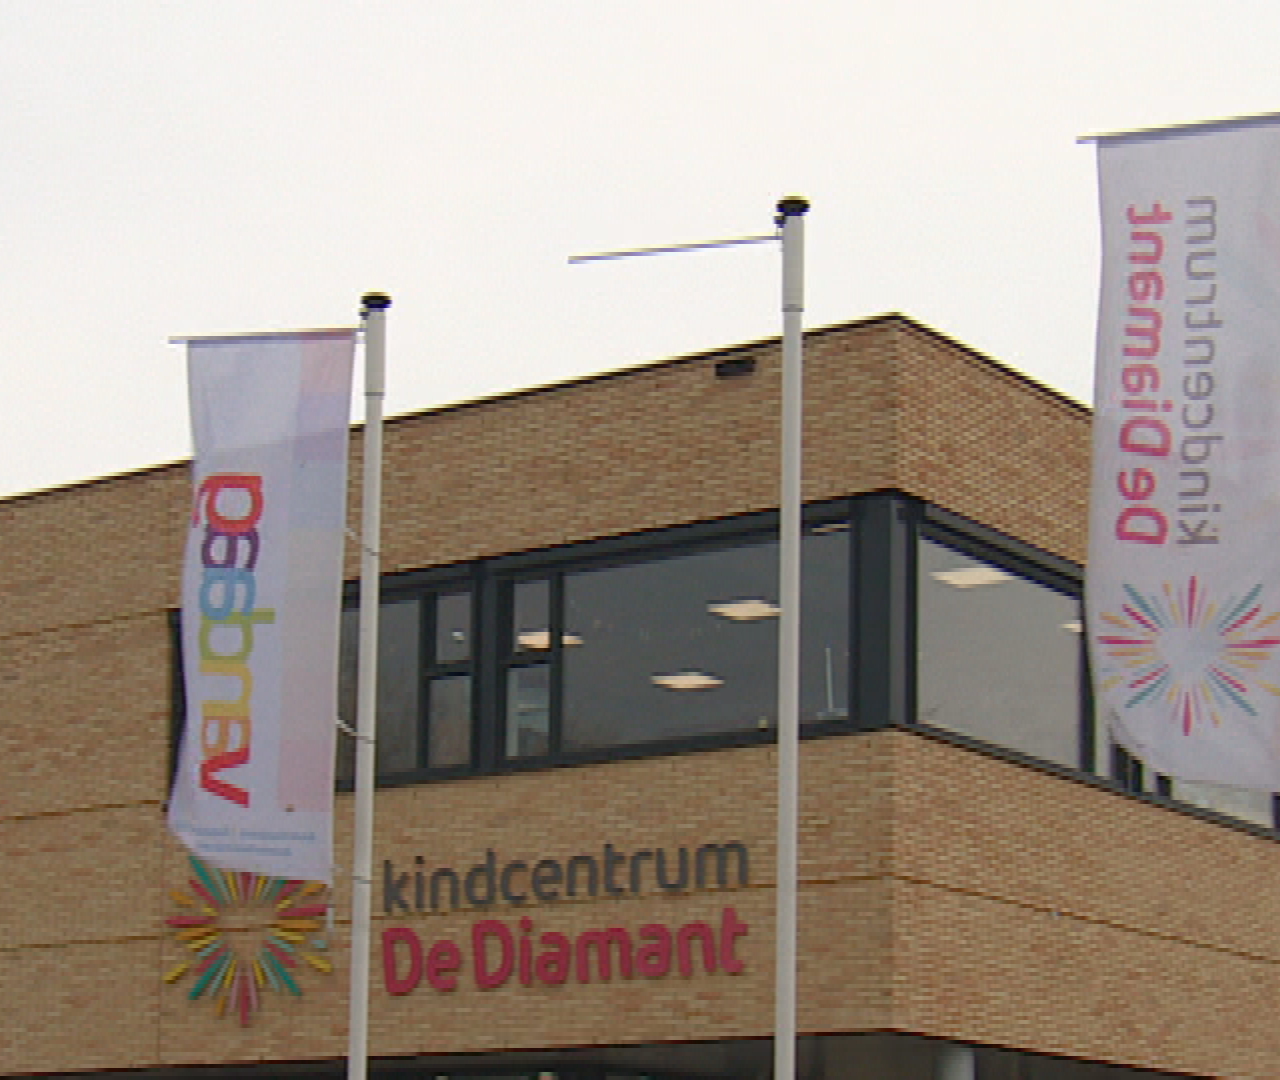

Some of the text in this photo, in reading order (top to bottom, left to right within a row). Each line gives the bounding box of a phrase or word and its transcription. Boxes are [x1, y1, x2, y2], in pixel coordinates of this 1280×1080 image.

[382, 840, 750, 914] kindcentrum
[382, 906, 749, 996] De Diamant
